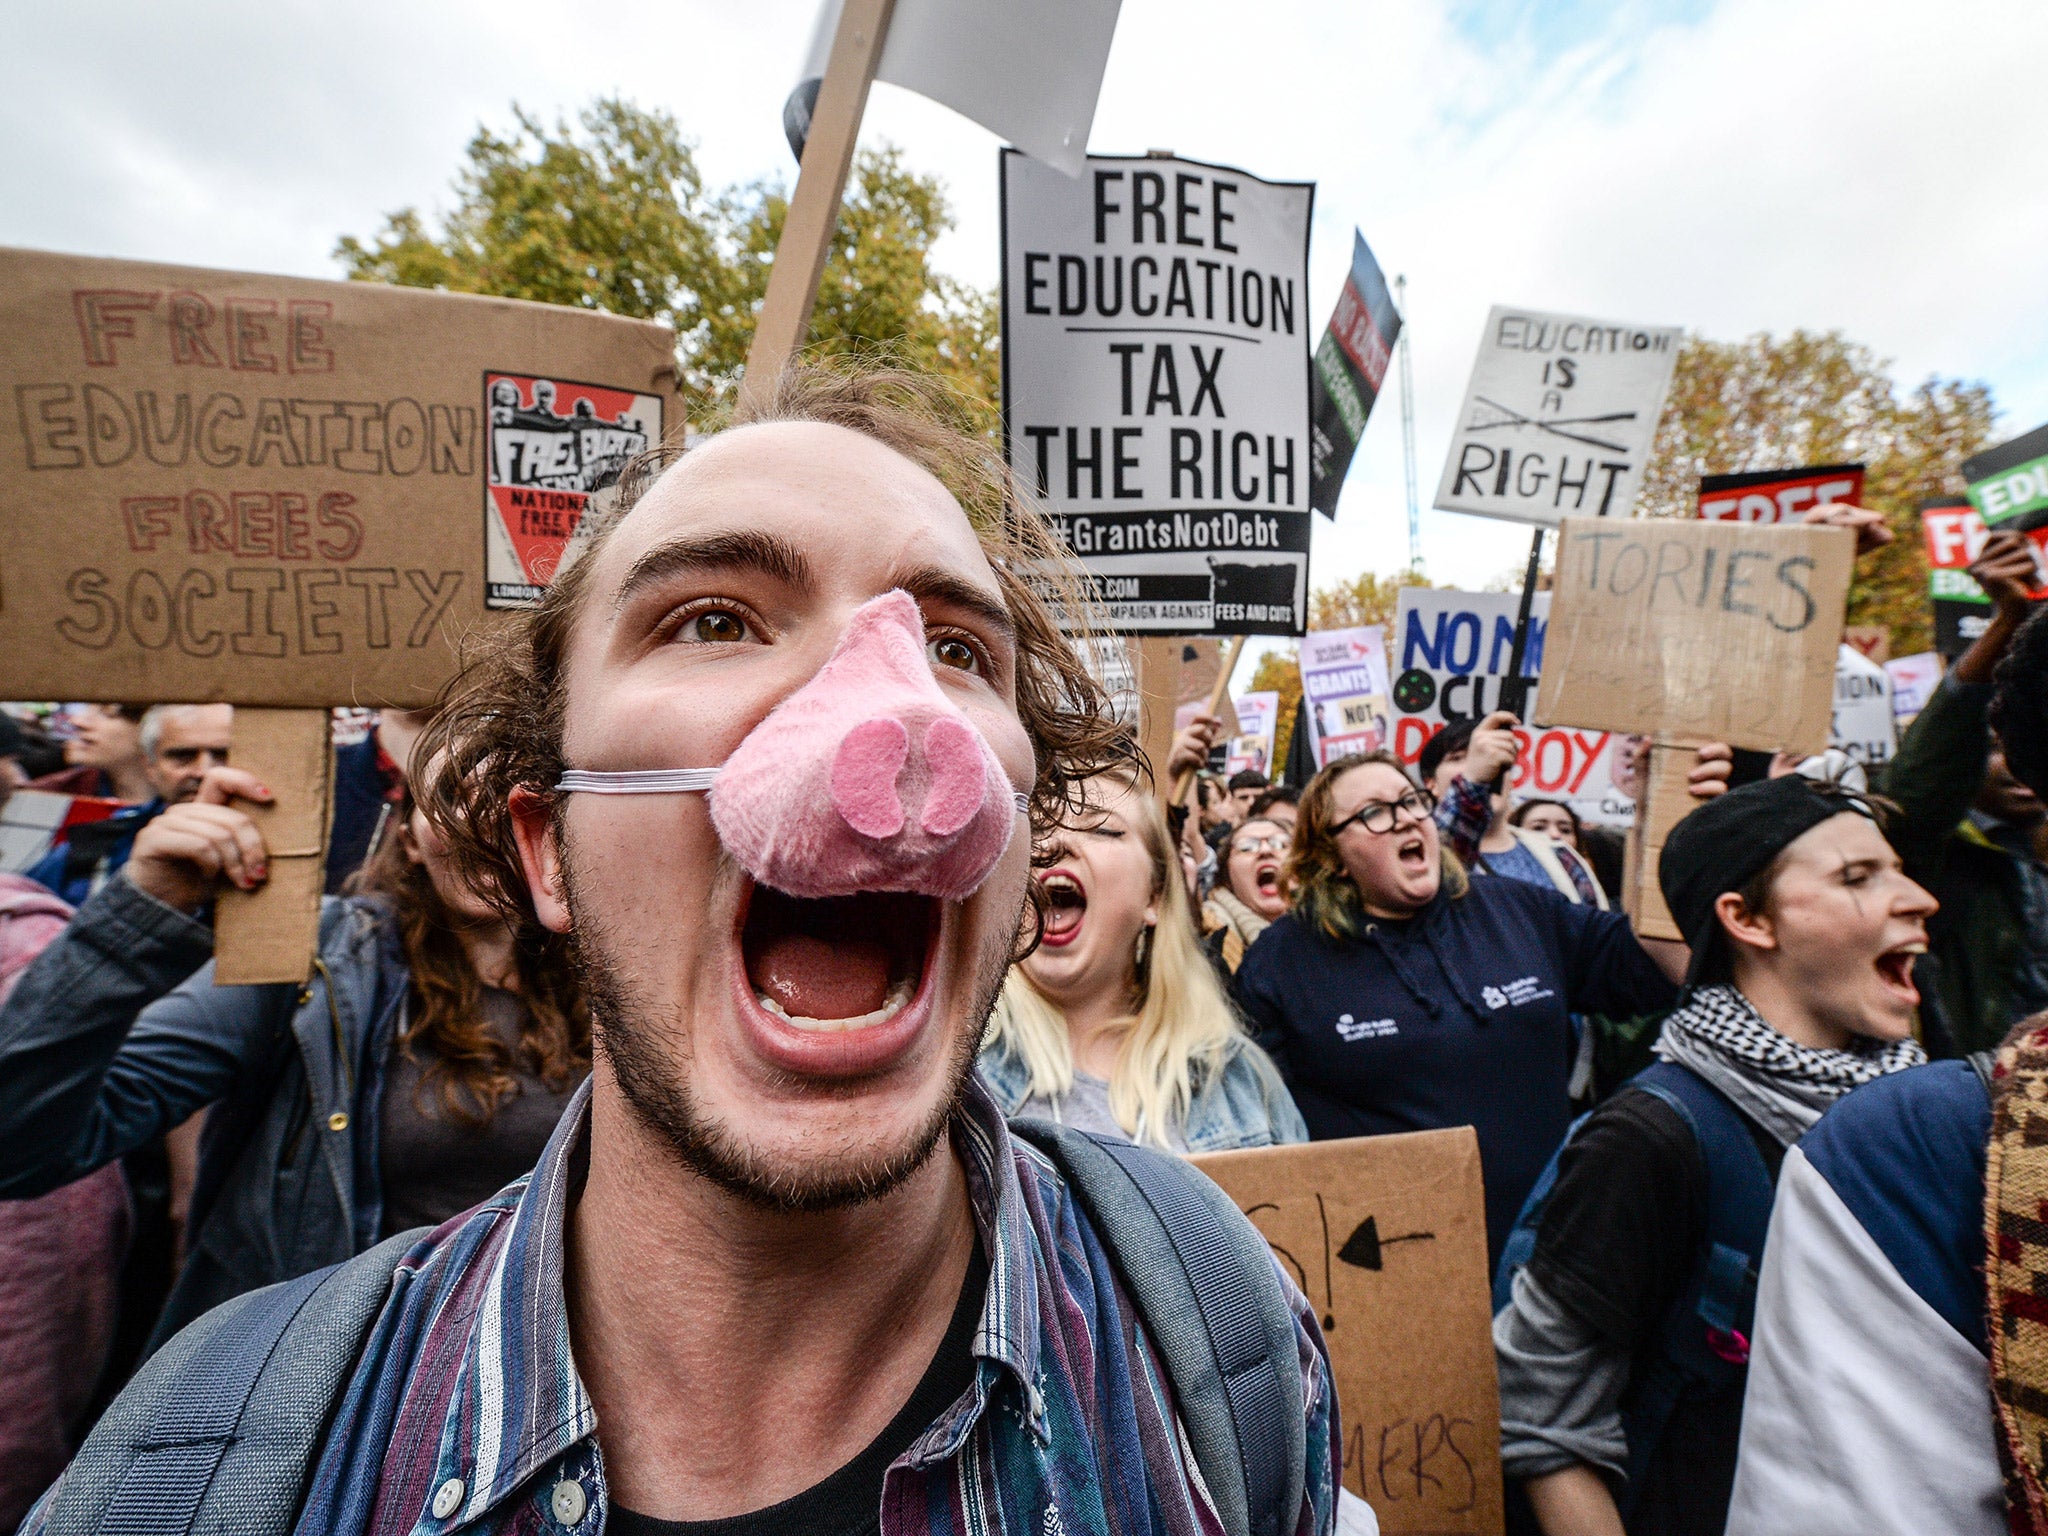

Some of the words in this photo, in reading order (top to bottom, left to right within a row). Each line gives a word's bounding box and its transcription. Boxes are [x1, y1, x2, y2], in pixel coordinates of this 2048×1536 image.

[1094, 170, 1239, 254] FREE
[72, 289, 335, 373] FREE
[1024, 252, 1295, 336] EDUCATION
[1497, 316, 1669, 353] EDUCATION
[1108, 343, 1227, 419] TAX
[1541, 390, 1562, 412] A
[1542, 358, 1577, 389] IS
[14, 384, 477, 475] EDUCATION
[1024, 426, 1144, 500] THE
[1170, 426, 1295, 506] RICH
[1452, 443, 1631, 516] RIGHT
[120, 490, 365, 561] FREES
[56, 568, 465, 658] SOCIETY
[1093, 603, 1156, 621] MPAIGN
[1215, 603, 1246, 621] FEES
[1246, 605, 1268, 621] AND
[1574, 530, 1818, 633] TORIES
[1402, 608, 1481, 676] NO
[1344, 704, 1374, 725] NOT
